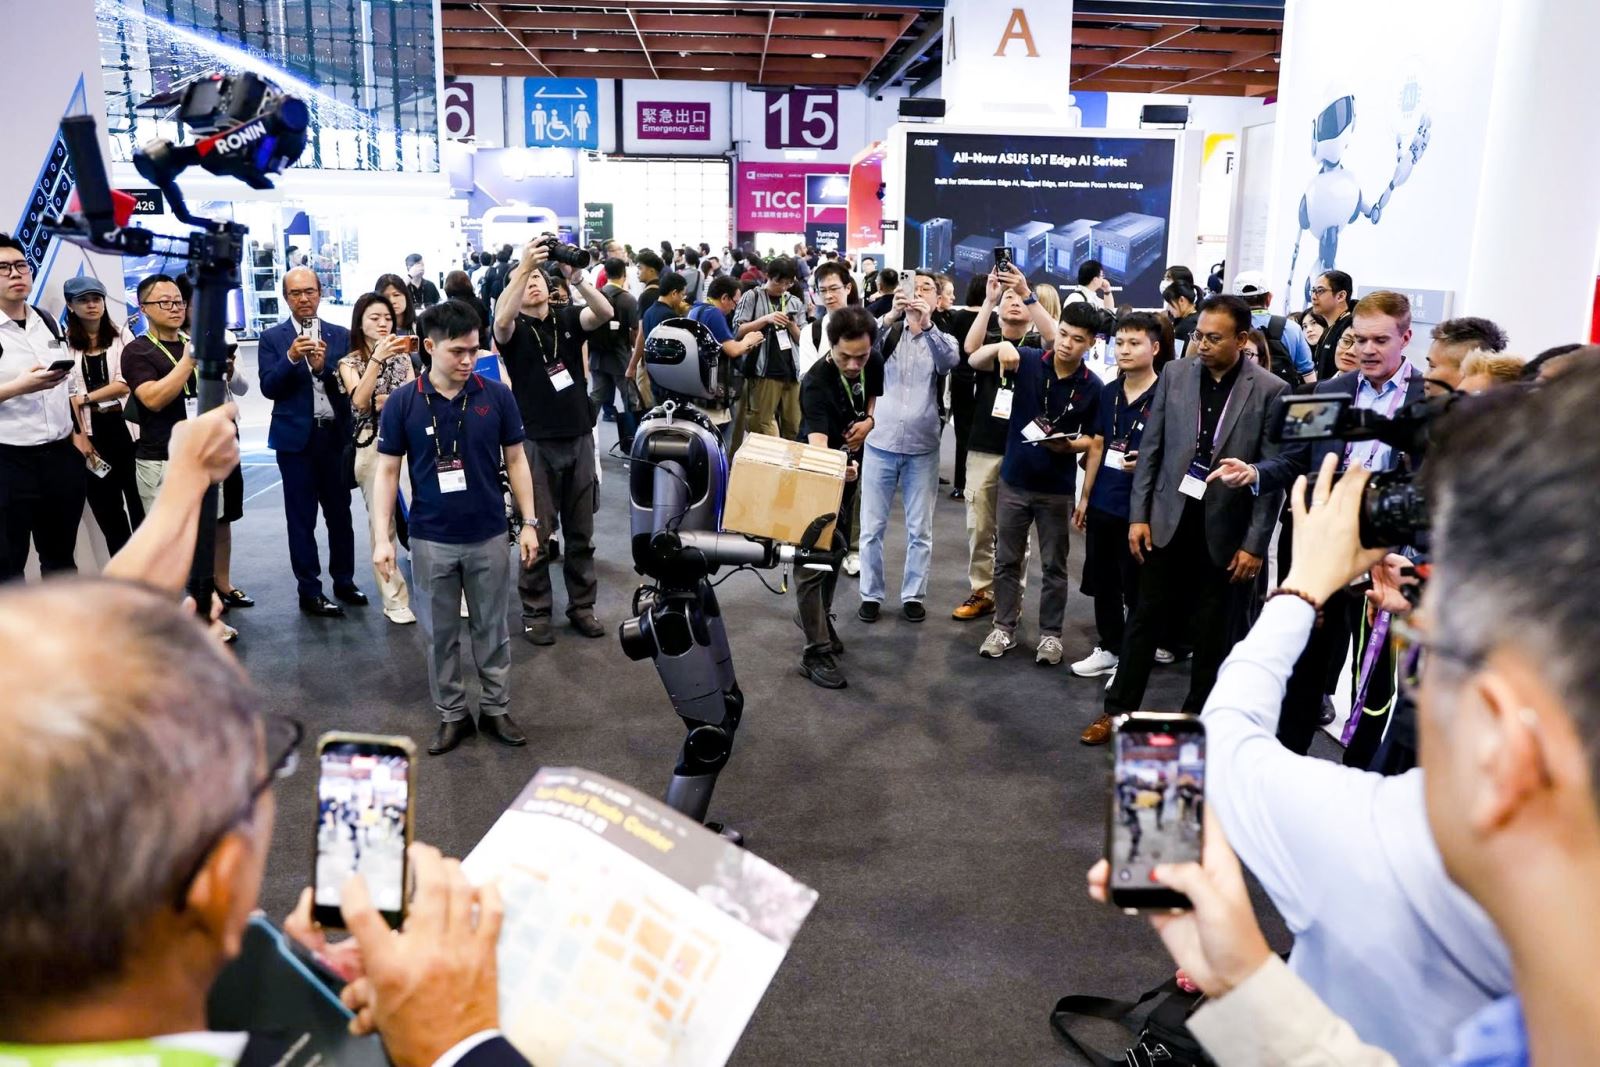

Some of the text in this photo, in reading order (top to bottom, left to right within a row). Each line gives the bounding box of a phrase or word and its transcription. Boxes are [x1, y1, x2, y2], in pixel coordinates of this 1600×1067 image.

[993, 8, 1040, 57] A
[445, 87, 470, 138] 6
[642, 107, 706, 124] 緊急出口
[768, 93, 835, 146] 15
[214, 120, 267, 155] RONIN
[642, 124, 705, 134] Emergency Exit
[952, 151, 1128, 168] All-New ASUS IoT Edge AI Series:
[934, 177, 948, 185] Built
[997, 178, 1011, 188] Edge
[1129, 182, 1144, 191] Edge
[133, 200, 155, 211] 426
[751, 191, 801, 209] TICC
